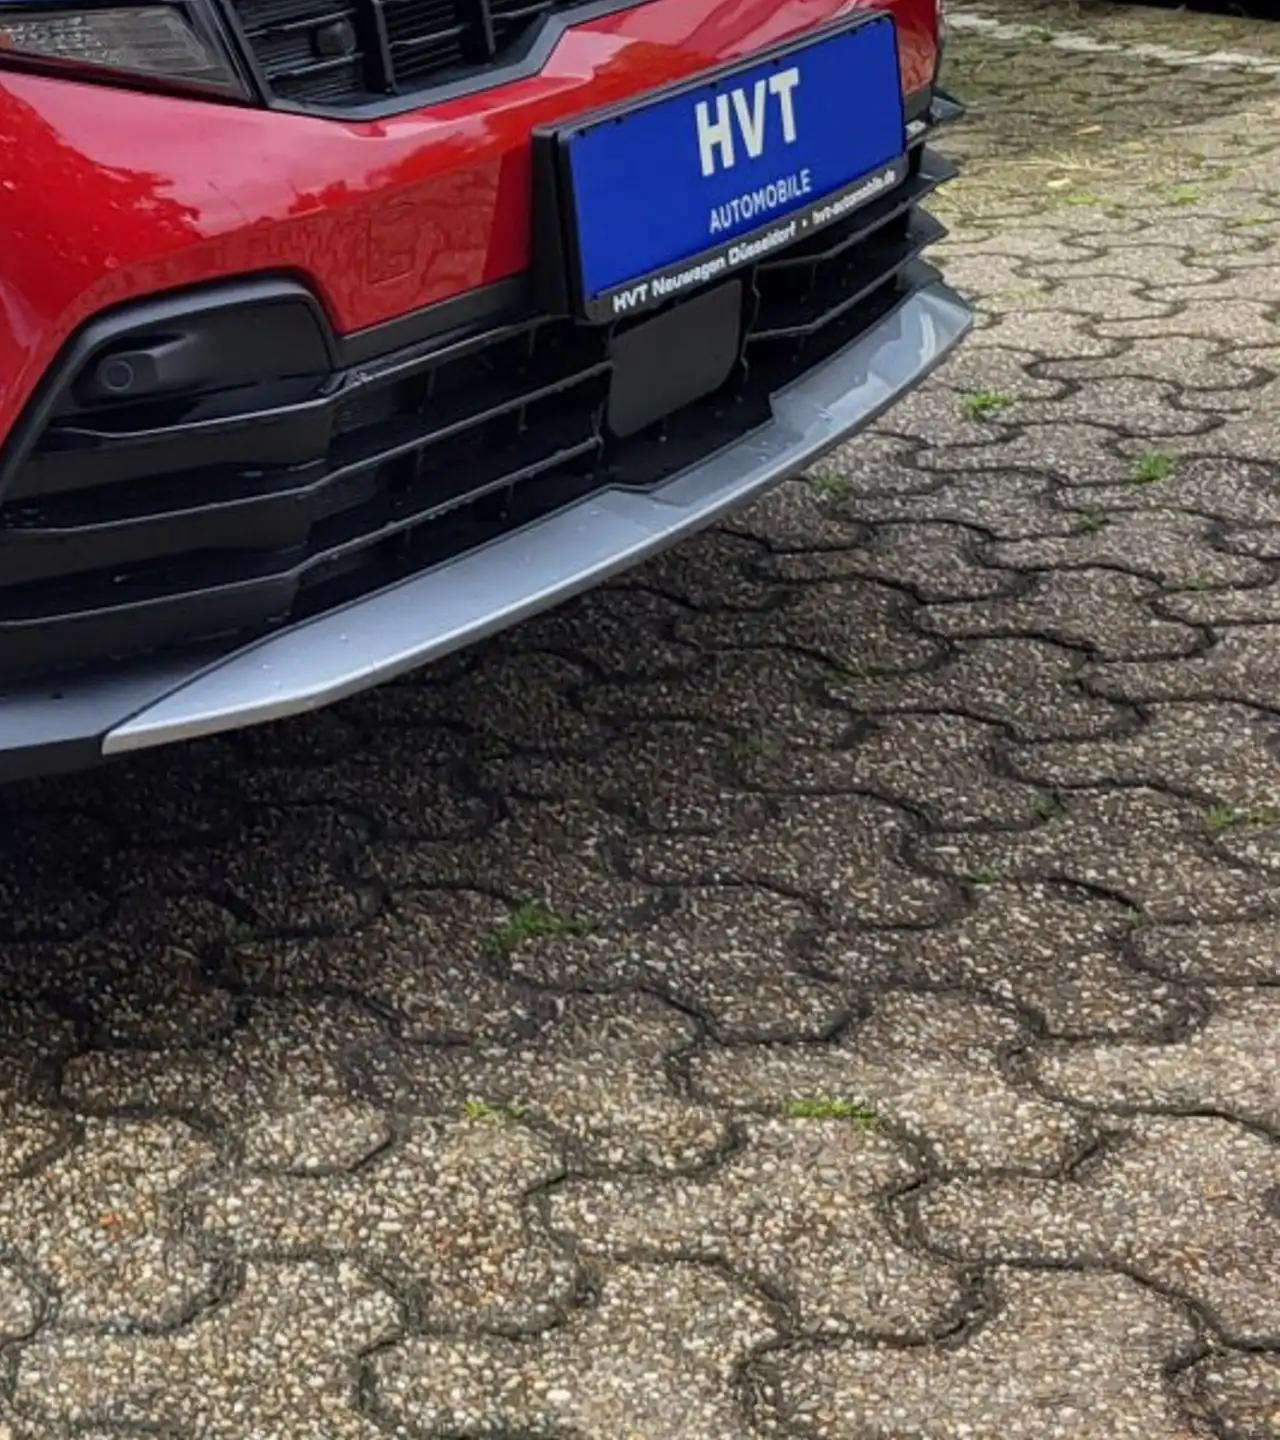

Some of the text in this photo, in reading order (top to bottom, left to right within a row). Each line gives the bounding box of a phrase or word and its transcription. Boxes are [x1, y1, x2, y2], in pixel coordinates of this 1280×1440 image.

[695, 67, 800, 177] HVT
[612, 169, 896, 312] HVT Neuwagen Düsseldorf hvt-automobile.de
[709, 168, 812, 234] AUTOMOBILE
